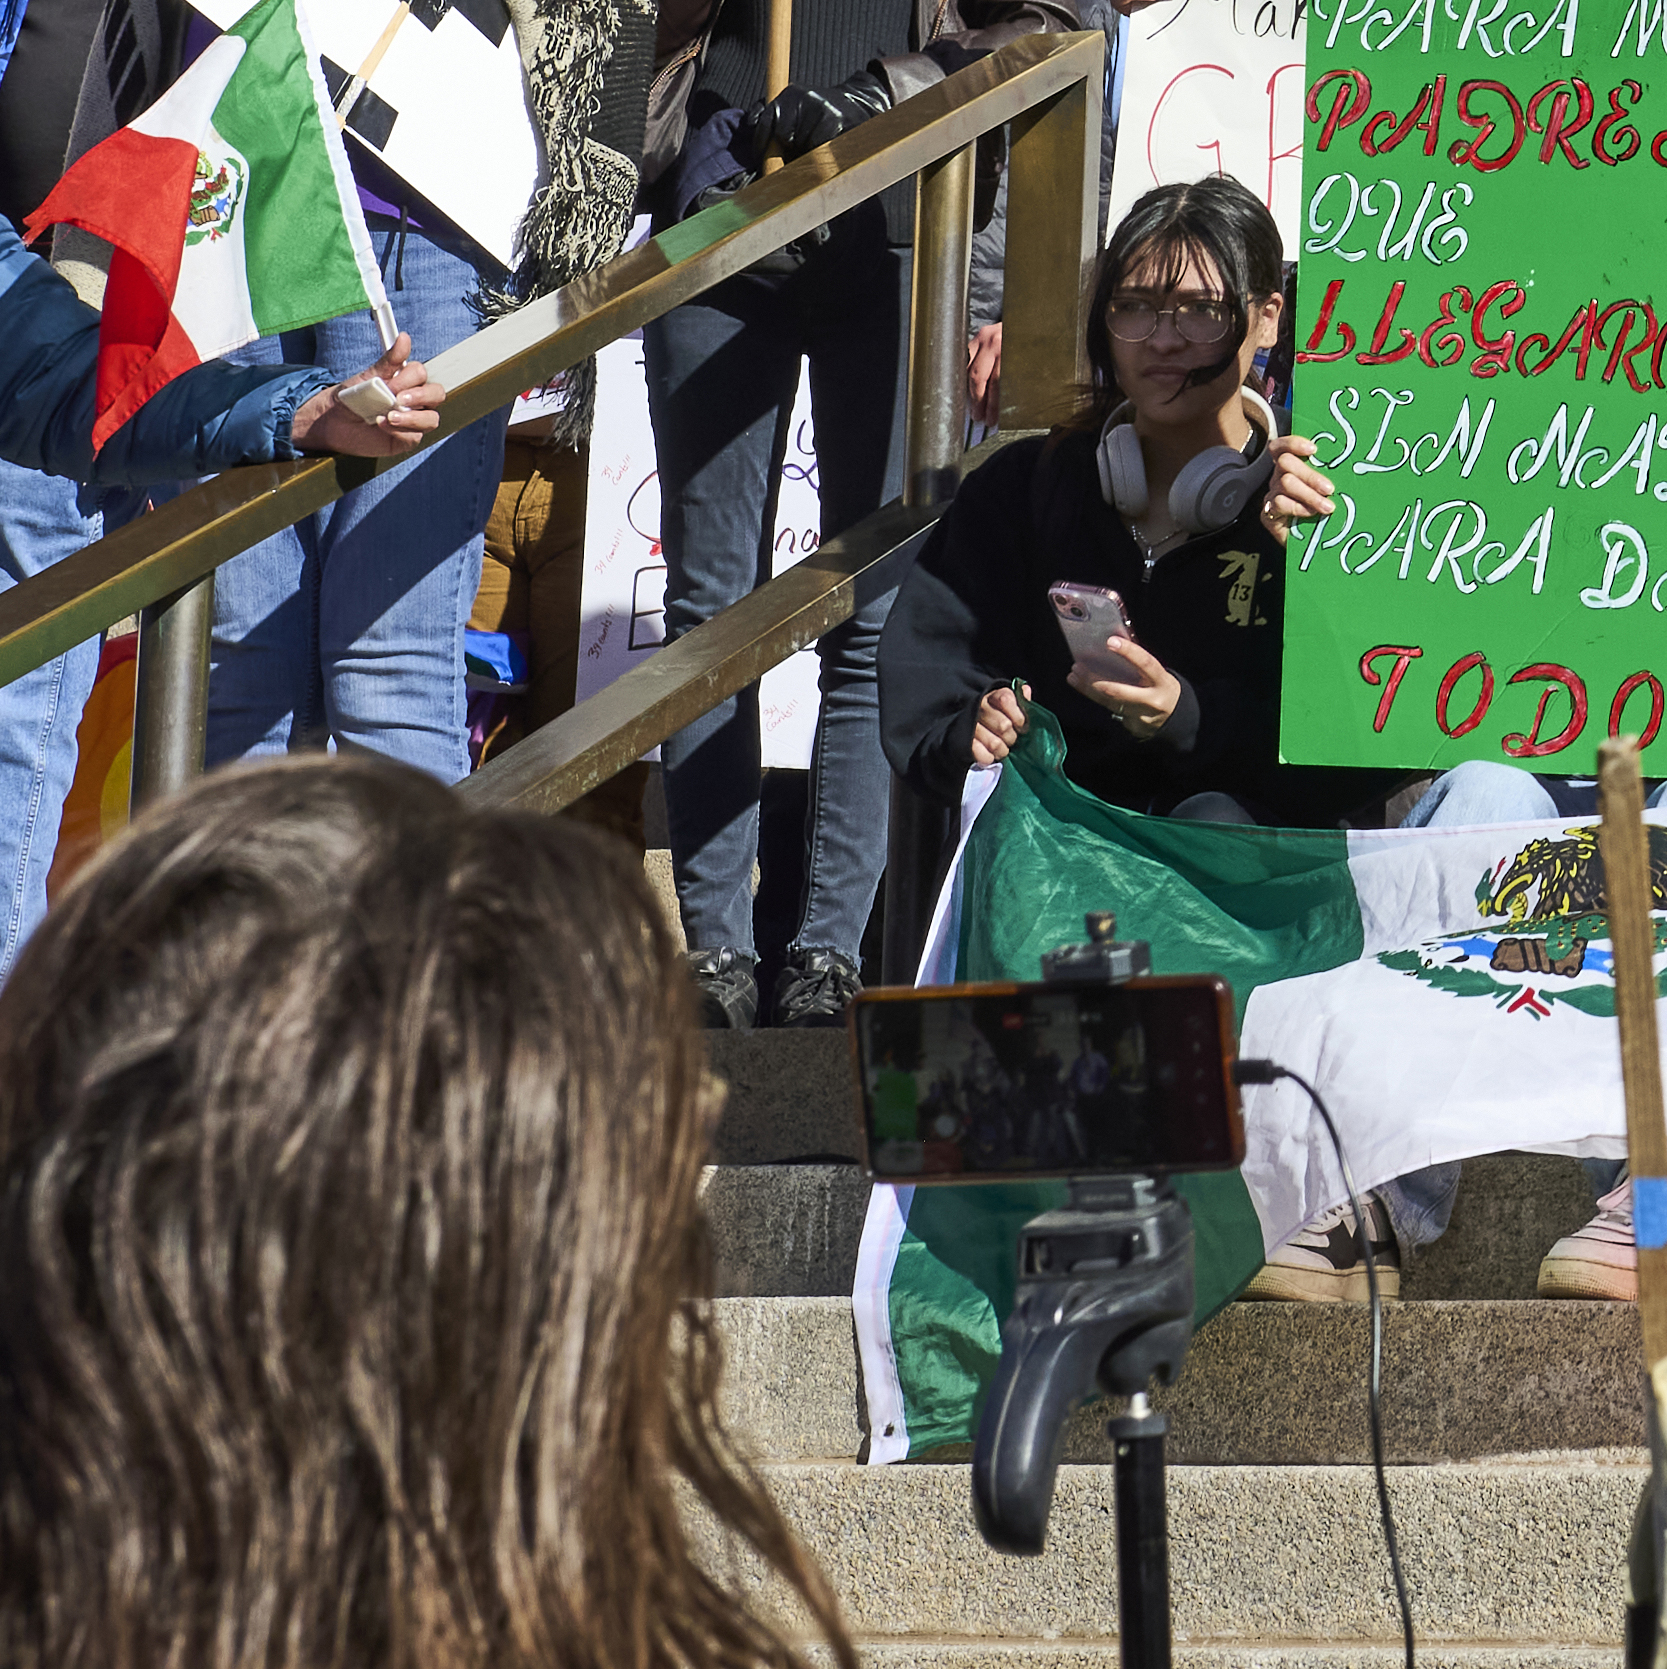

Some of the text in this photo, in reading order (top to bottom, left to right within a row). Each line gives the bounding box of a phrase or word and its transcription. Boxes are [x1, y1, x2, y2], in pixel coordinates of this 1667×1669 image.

[1305, 172, 1475, 266] QUE
[1308, 385, 1497, 479] SIN
[1291, 492, 1556, 595] PARA
[1232, 583, 1252, 602] 13
